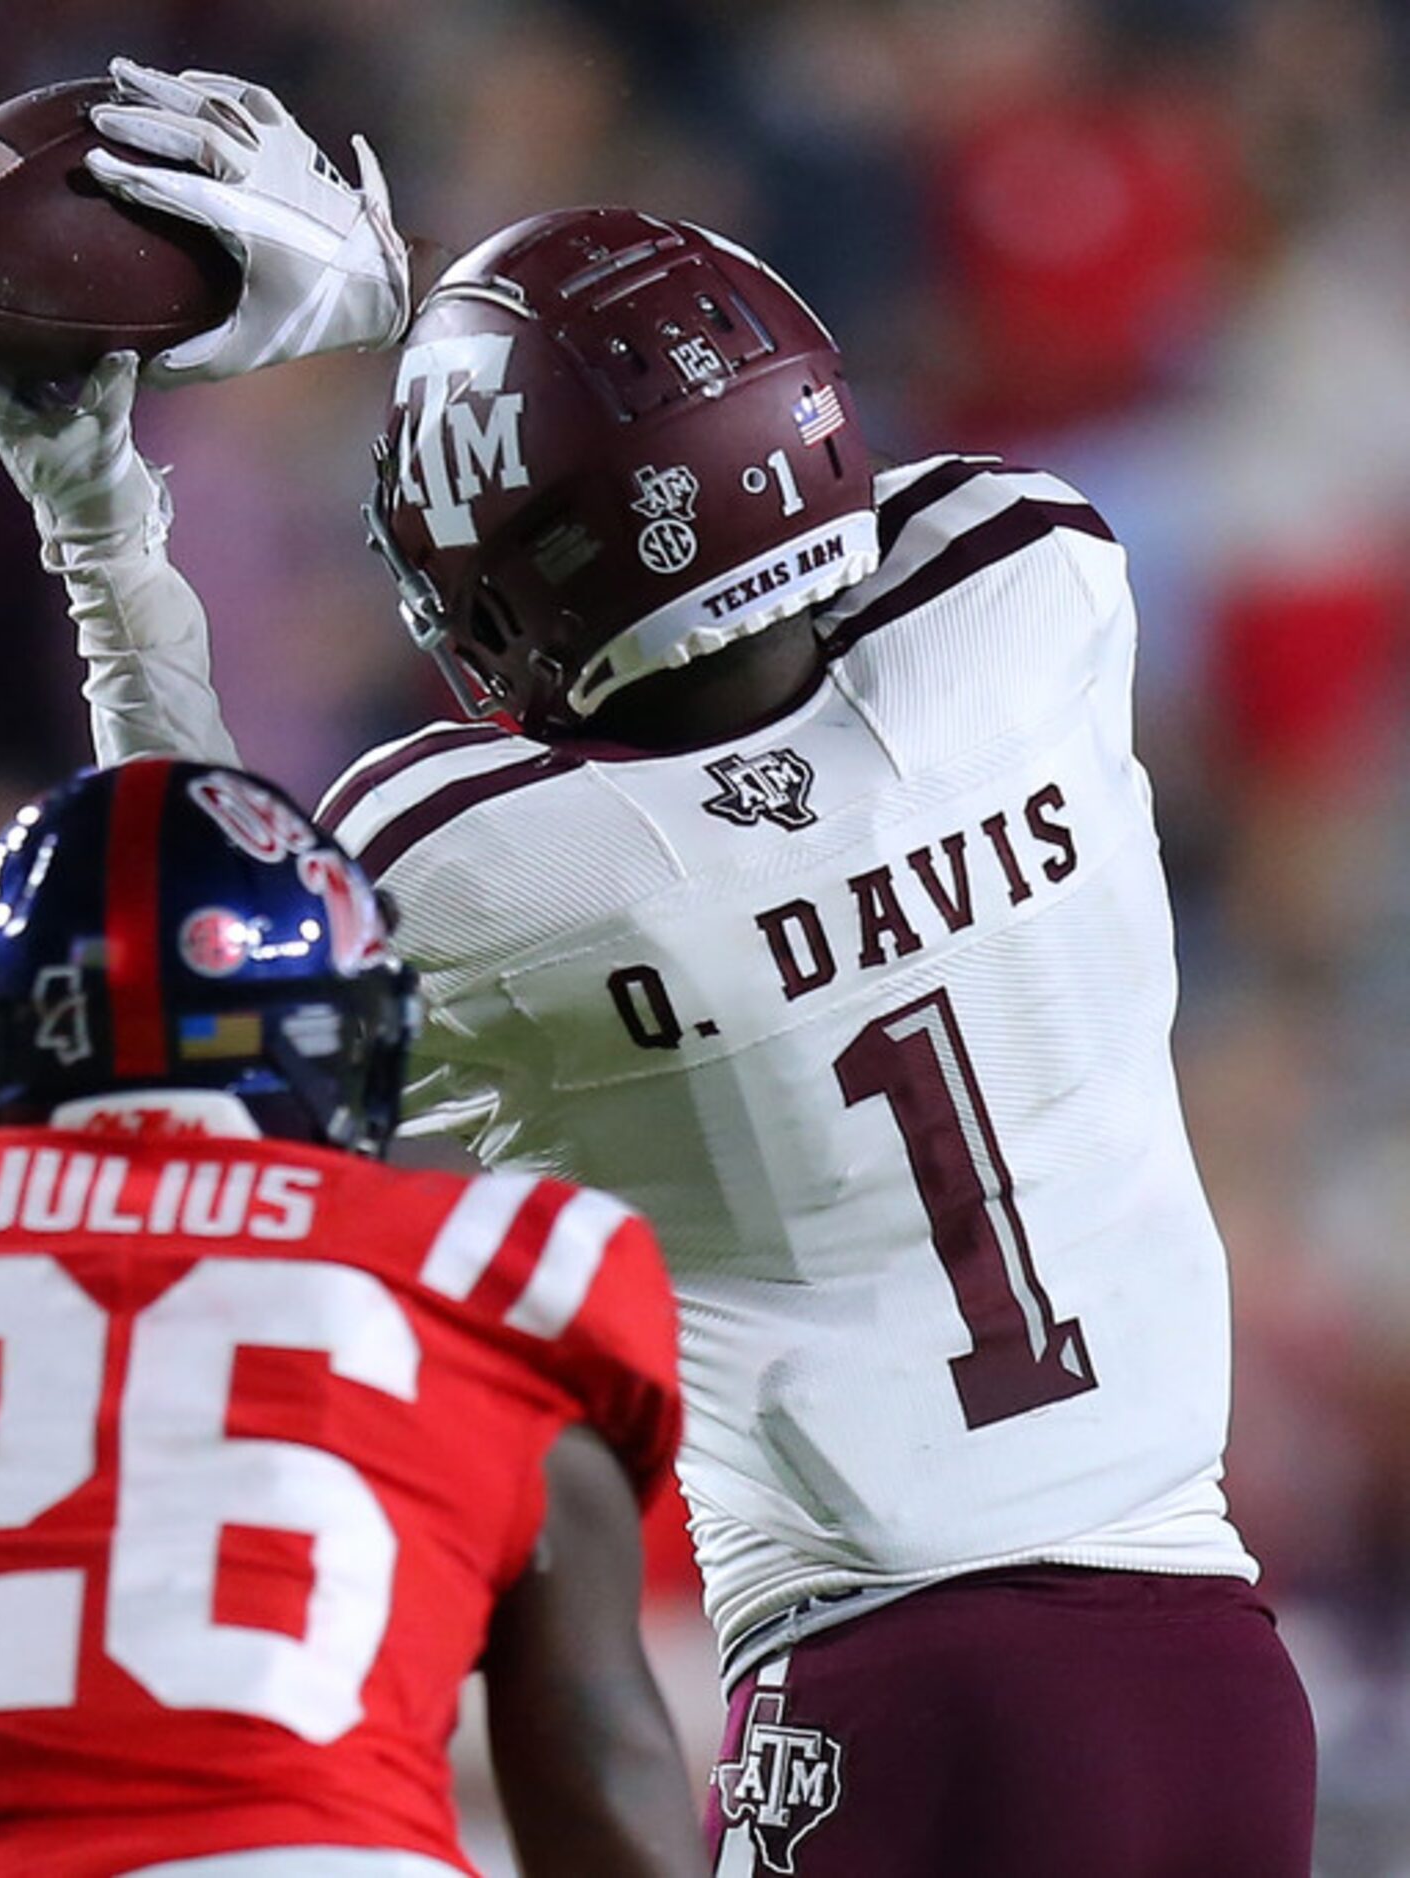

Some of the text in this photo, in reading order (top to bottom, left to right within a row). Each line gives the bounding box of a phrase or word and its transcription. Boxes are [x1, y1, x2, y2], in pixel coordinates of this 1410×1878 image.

[768, 450, 804, 516] 1
[643, 523, 691, 568] SEC
[702, 562, 790, 618] TEXAS
[608, 784, 1077, 1049] Q. DAVIS
[834, 987, 1098, 1430] 1
